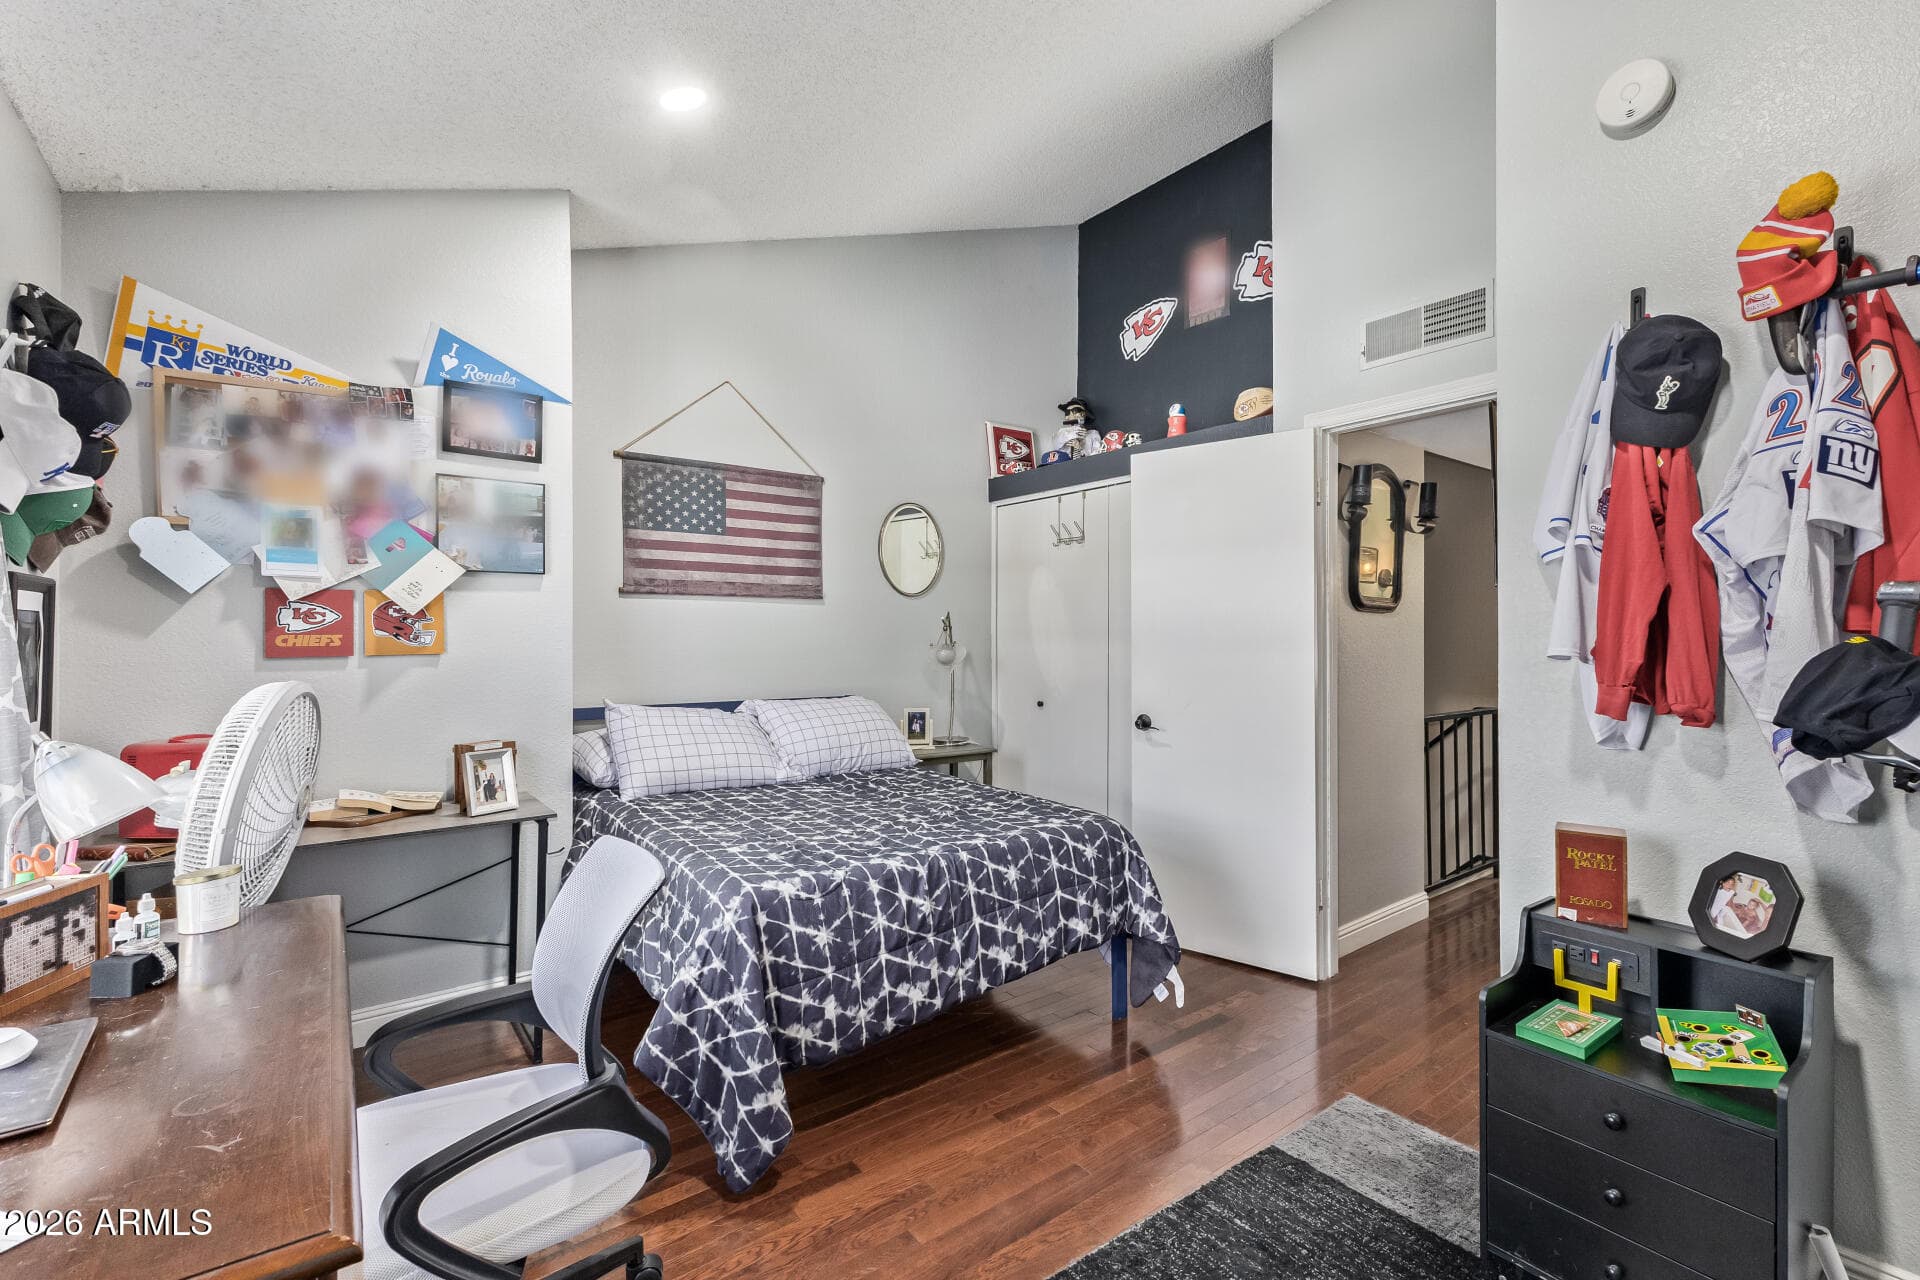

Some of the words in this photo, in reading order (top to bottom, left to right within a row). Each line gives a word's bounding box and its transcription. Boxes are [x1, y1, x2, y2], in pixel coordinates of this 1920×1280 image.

[1132, 308, 1165, 340] KC
[171, 335, 191, 352] KC
[449, 343, 459, 357] I
[202, 350, 269, 377] SERIES
[226, 343, 292, 371] WORLD
[461, 363, 518, 387] Royals
[1831, 360, 1867, 410] 2
[1765, 389, 1807, 443] 2
[292, 607, 326, 625] KC
[274, 634, 343, 648] CHIEFS
[1567, 847, 1616, 861] ROCKY
[1574, 858, 1617, 872] PATEL
[1569, 895, 1613, 910] ROSADO
